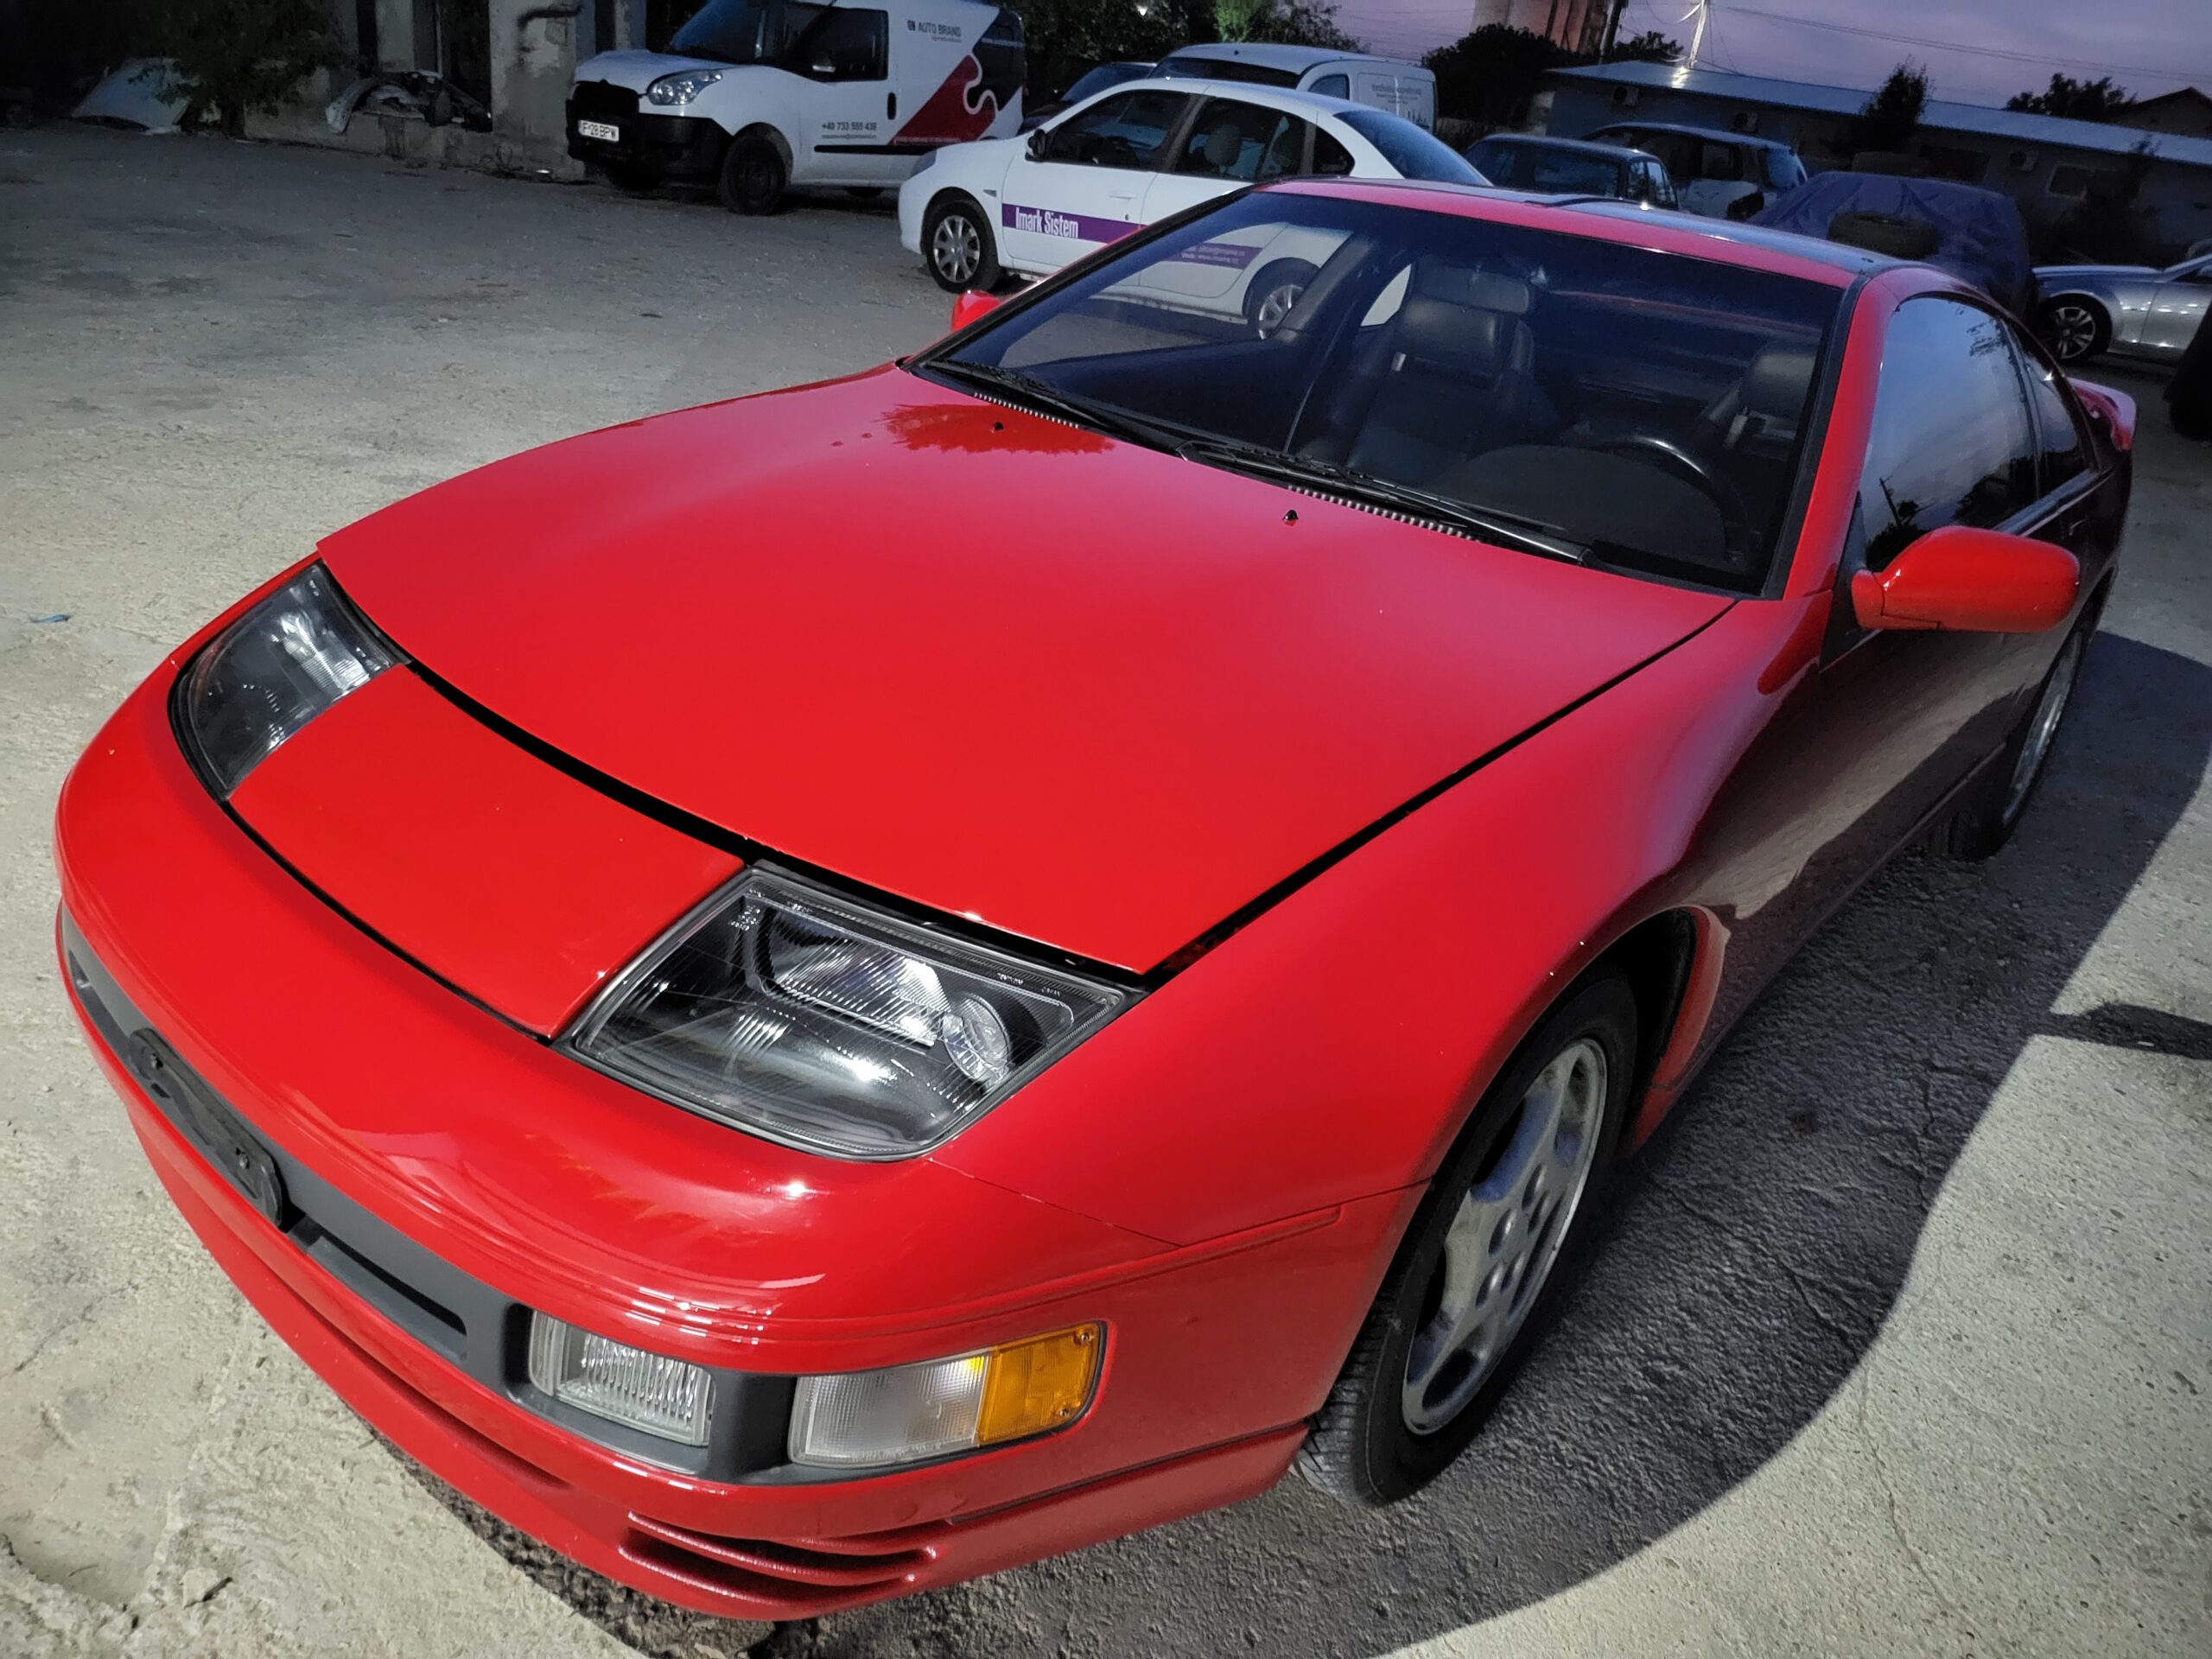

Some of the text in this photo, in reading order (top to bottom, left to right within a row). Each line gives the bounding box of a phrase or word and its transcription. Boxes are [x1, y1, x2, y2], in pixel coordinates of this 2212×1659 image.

[918, 22, 937, 34] AUTO
[938, 24, 961, 36] BRAND
[1015, 207, 1079, 239] Imark Sistem
